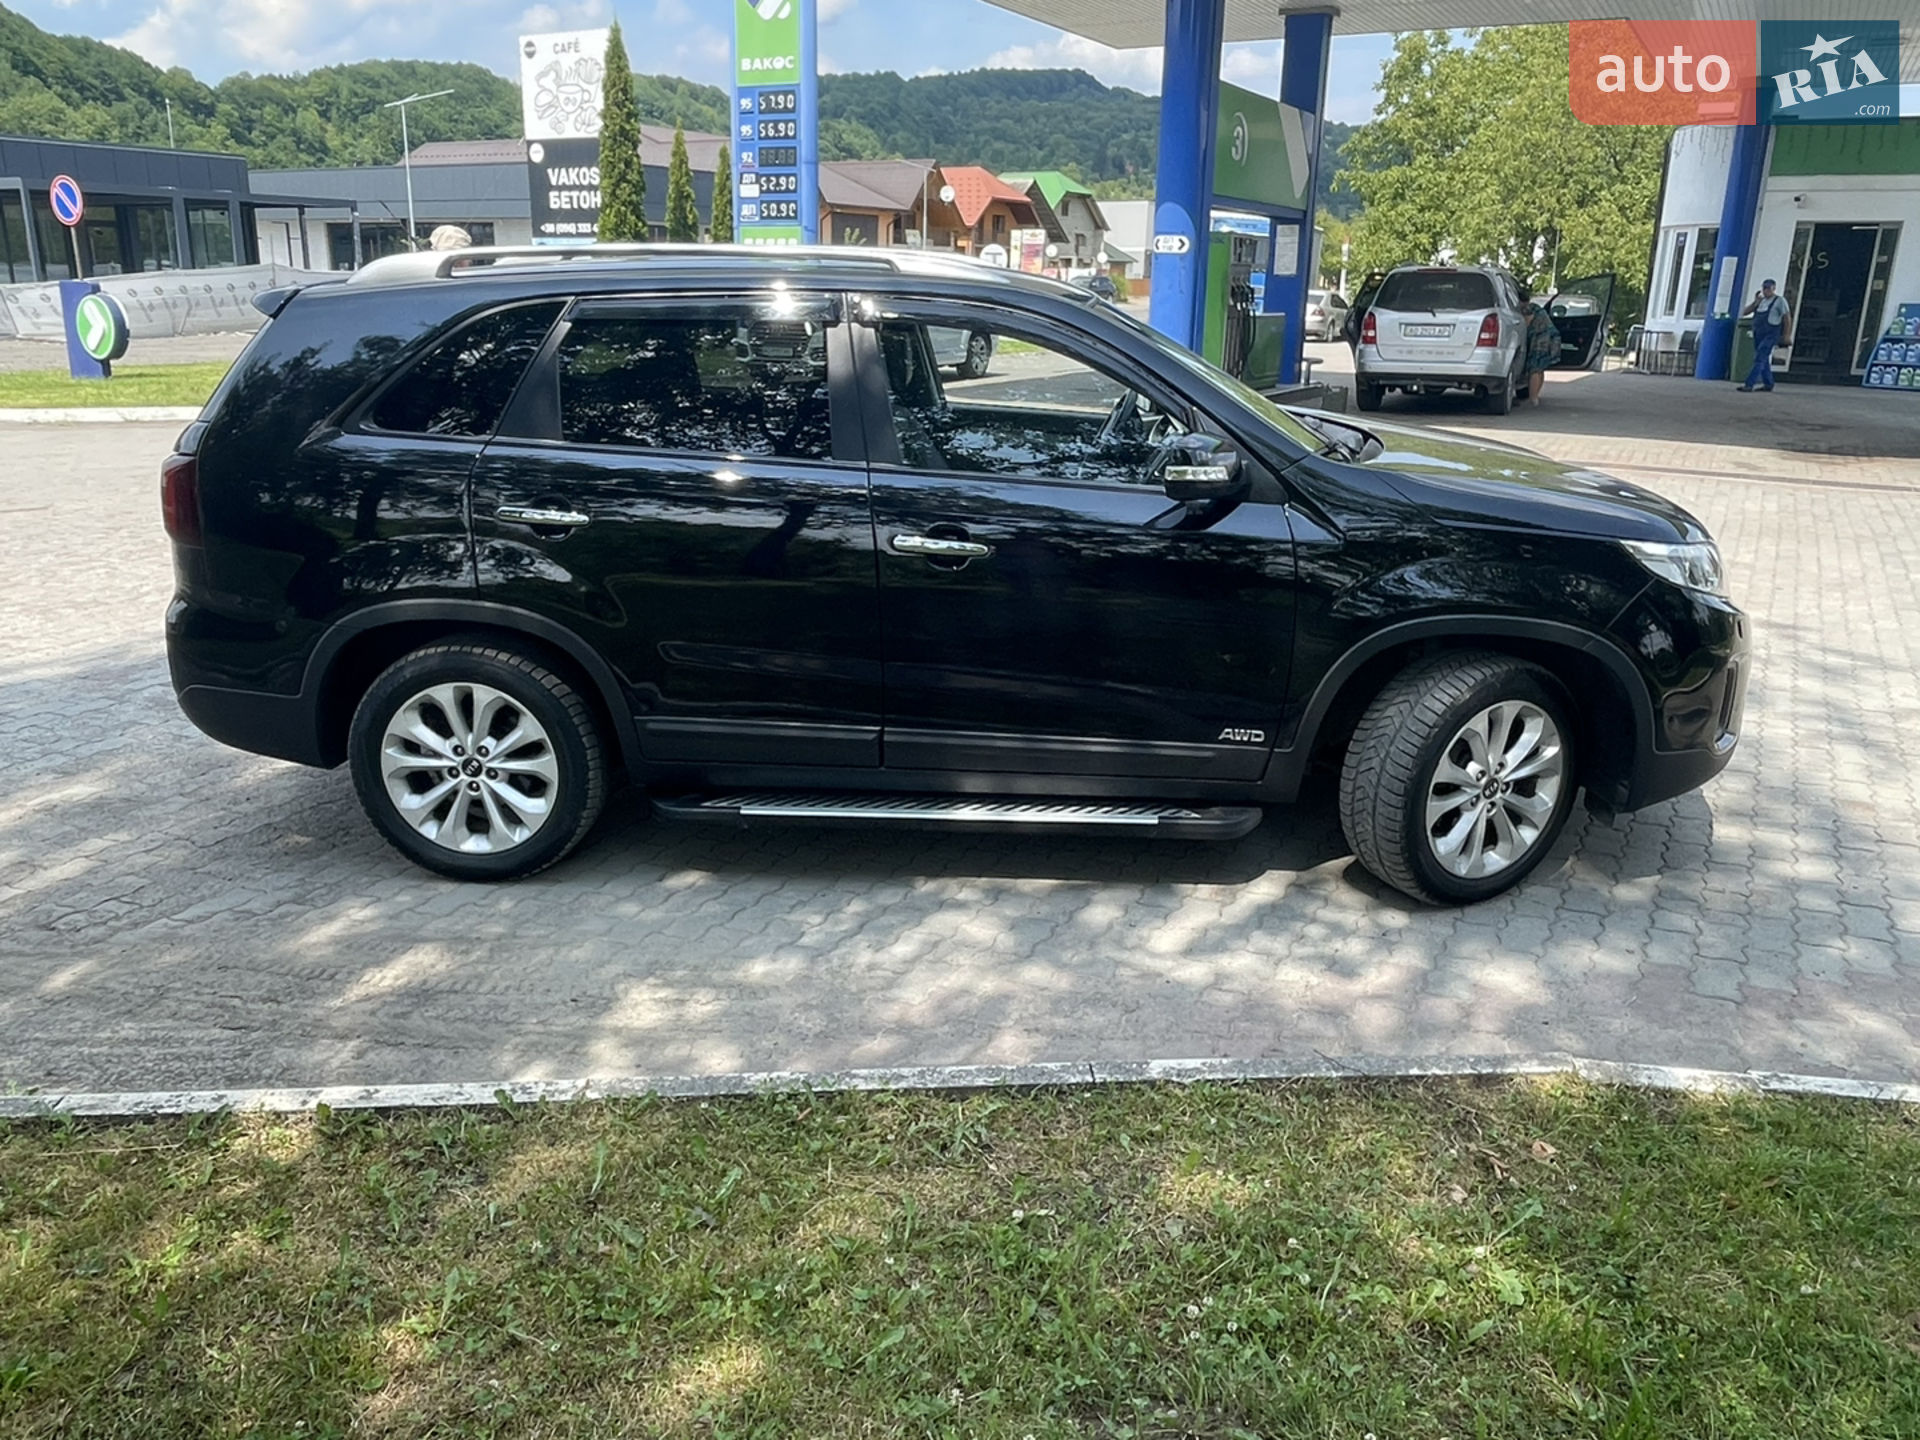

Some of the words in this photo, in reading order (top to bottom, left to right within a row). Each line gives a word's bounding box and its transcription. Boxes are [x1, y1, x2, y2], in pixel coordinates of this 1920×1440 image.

[553, 37, 580, 54] CAFÉ
[740, 98, 752, 109] 95
[740, 125, 752, 137] 95
[759, 122, 795, 137] 56.90
[1231, 126, 1243, 161] 3
[741, 152, 753, 163] 92
[547, 167, 600, 186] VAKOS
[761, 176, 796, 191] 52.90
[549, 191, 601, 209] БЕТОН
[1218, 728, 1265, 742] AWD
